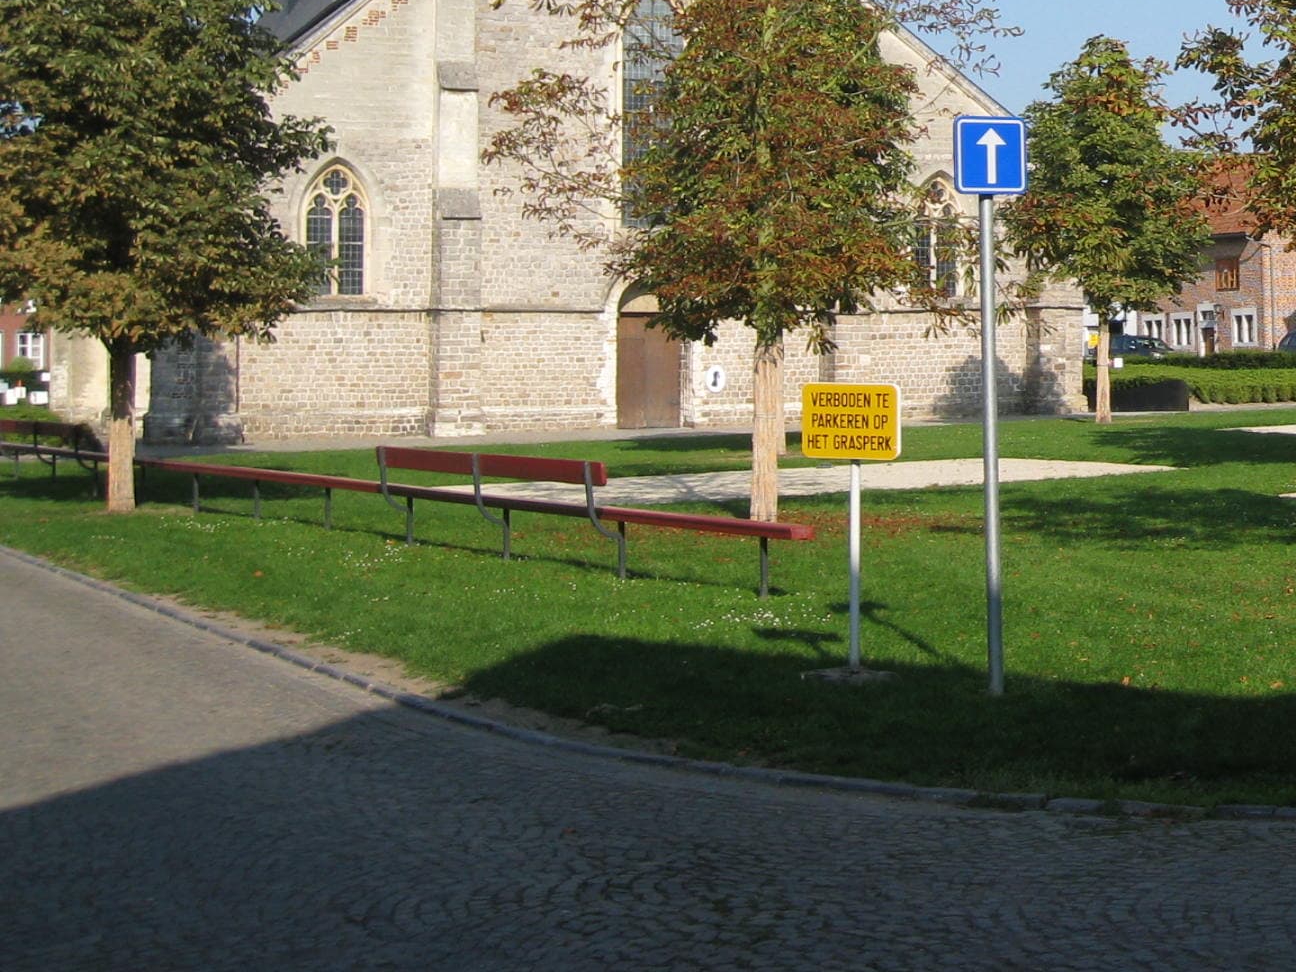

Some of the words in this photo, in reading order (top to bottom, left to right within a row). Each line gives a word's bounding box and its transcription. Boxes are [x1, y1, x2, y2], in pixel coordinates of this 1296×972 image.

[811, 392, 871, 408] VERBODEN
[875, 393, 890, 409] TE
[811, 413, 869, 429] PARKEREN
[873, 414, 889, 430] OP
[807, 434, 829, 449] HET
[833, 434, 892, 451] GRASPERK
